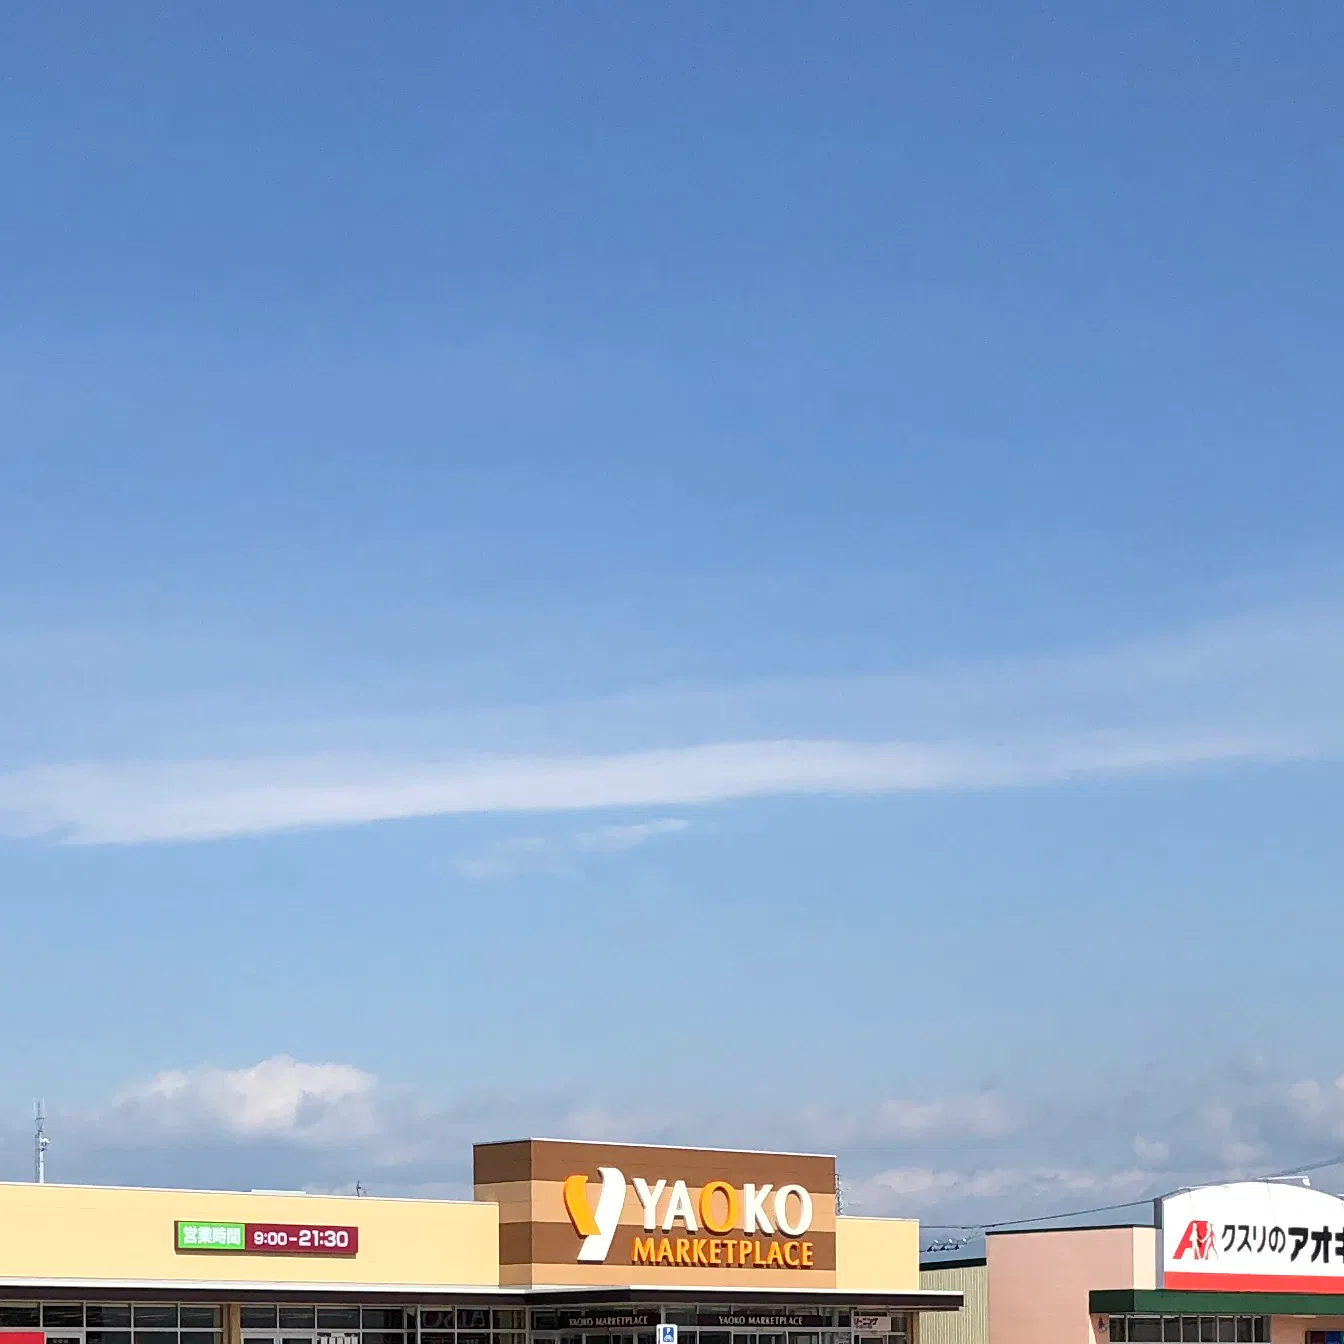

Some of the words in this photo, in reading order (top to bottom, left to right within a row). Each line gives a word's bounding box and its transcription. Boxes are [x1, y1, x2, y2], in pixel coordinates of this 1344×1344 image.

[632, 1178, 813, 1236] YAOKO
[183, 1226, 241, 1245] 営業時間
[632, 1237, 814, 1268] MARKETPLACE
[569, 1317, 594, 1326] YAOKO
[596, 1316, 648, 1325] MARKETPLACE
[718, 1316, 746, 1325] YAOKO
[748, 1316, 803, 1325] MARKETPLACE
